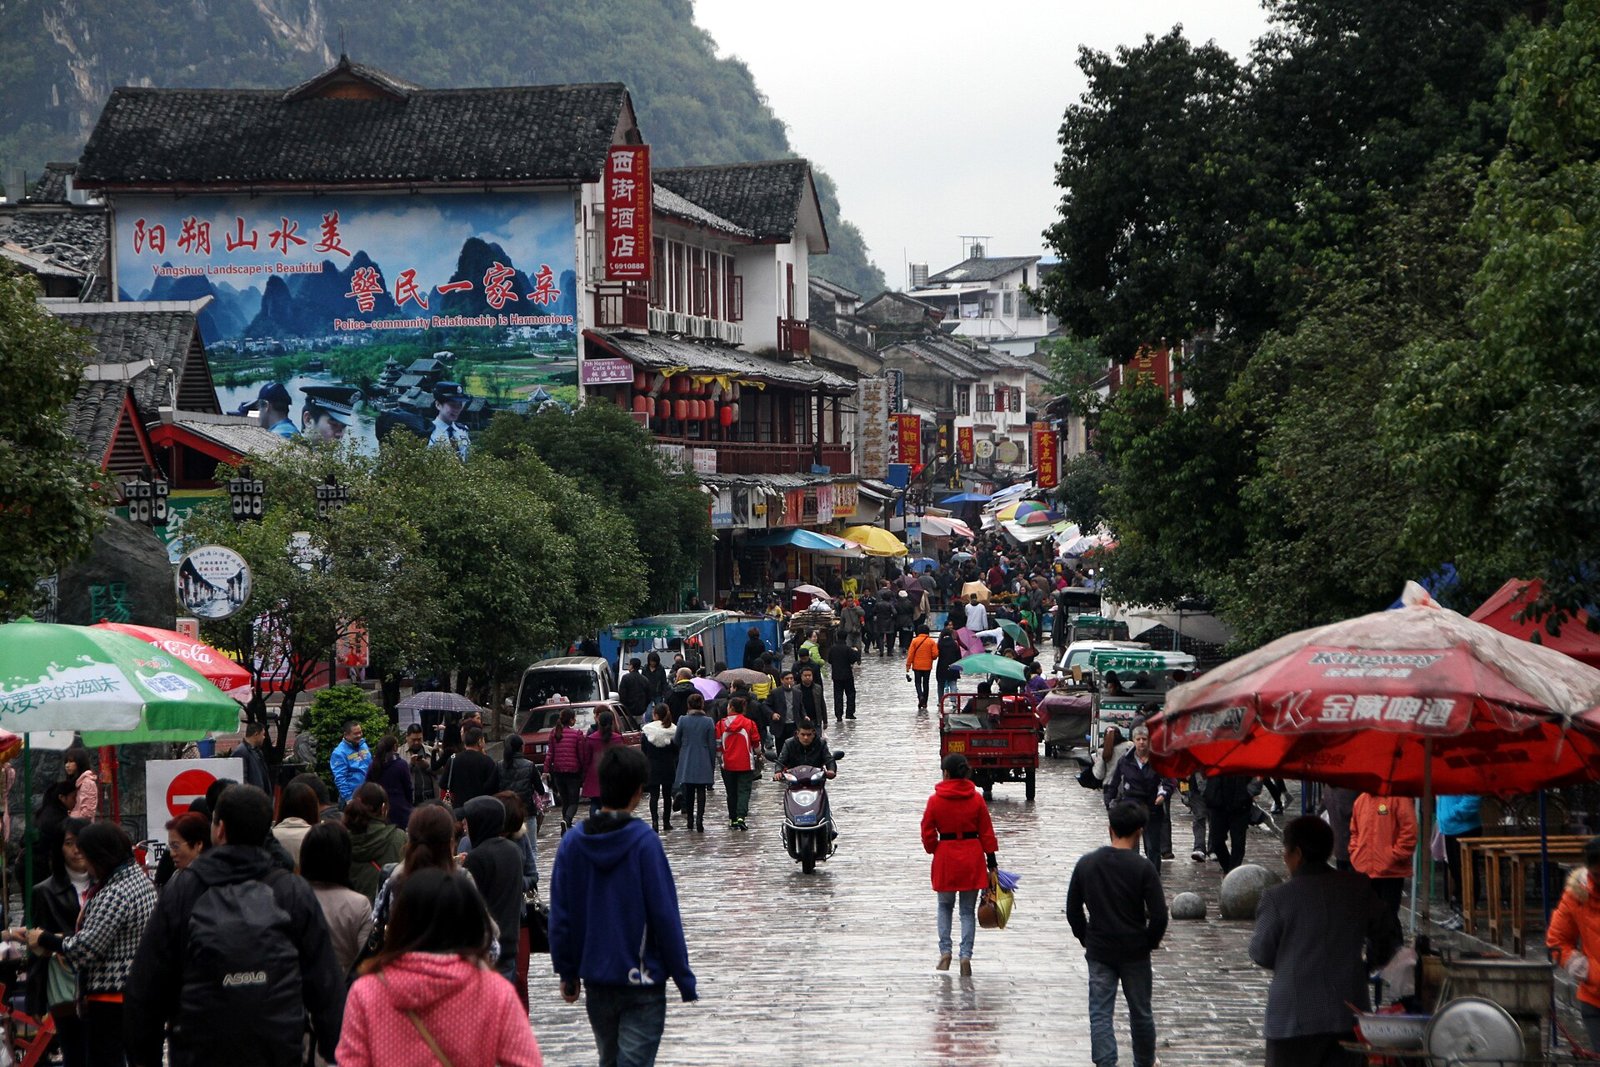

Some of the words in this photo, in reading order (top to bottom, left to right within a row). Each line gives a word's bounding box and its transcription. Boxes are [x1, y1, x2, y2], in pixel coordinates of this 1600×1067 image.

[611, 151, 636, 257] 西街酒店
[133, 209, 351, 257] 阳朔山水美
[152, 264, 204, 277] Yangshuo
[207, 263, 262, 276] Landscape
[264, 264, 273, 274] is
[276, 262, 323, 273] Beautiful
[344, 261, 561, 313] 警民一家亲
[334, 317, 430, 331] Police-community
[431, 315, 496, 328] Relationship
[498, 315, 508, 325] is
[510, 313, 573, 326] Harmonious
[1308, 651, 1444, 668] Kingway
[222, 971, 267, 986] ASOLO
